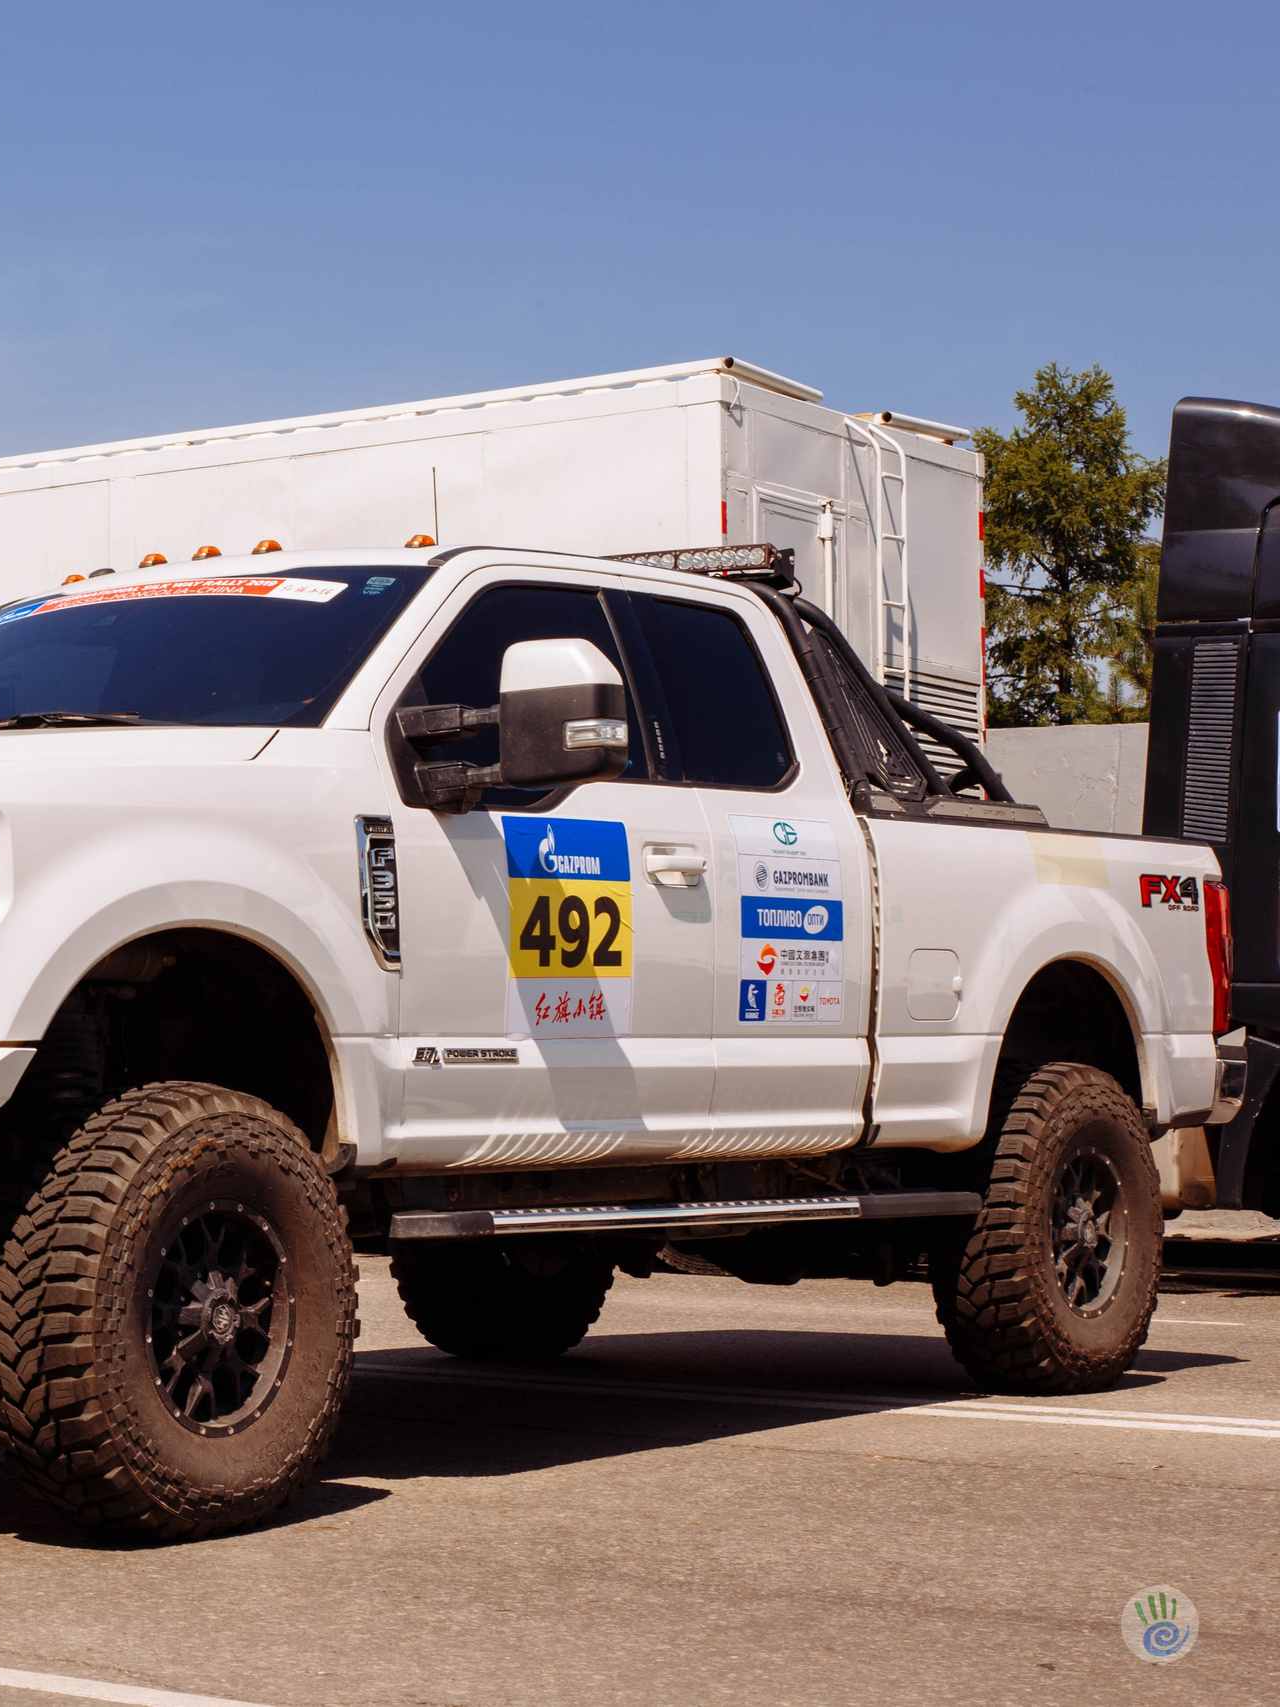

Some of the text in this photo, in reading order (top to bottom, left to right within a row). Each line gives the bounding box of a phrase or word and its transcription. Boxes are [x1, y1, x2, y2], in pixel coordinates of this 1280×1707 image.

[173, 580, 203, 589] WAY
[202, 579, 247, 588] RALLY
[245, 579, 279, 588] 2019
[557, 855, 601, 875] GAZPROM
[773, 870, 829, 887] GAZPROMBANK
[1139, 874, 1199, 908] FX4
[757, 908, 824, 928] ТОПЛИВО ОПТИ
[520, 894, 622, 968] 492
[535, 988, 606, 1027] 红旗小镇
[819, 997, 840, 1006] TOYOTA
[446, 1049, 479, 1058] POWER
[480, 1049, 517, 1058] STROKE
